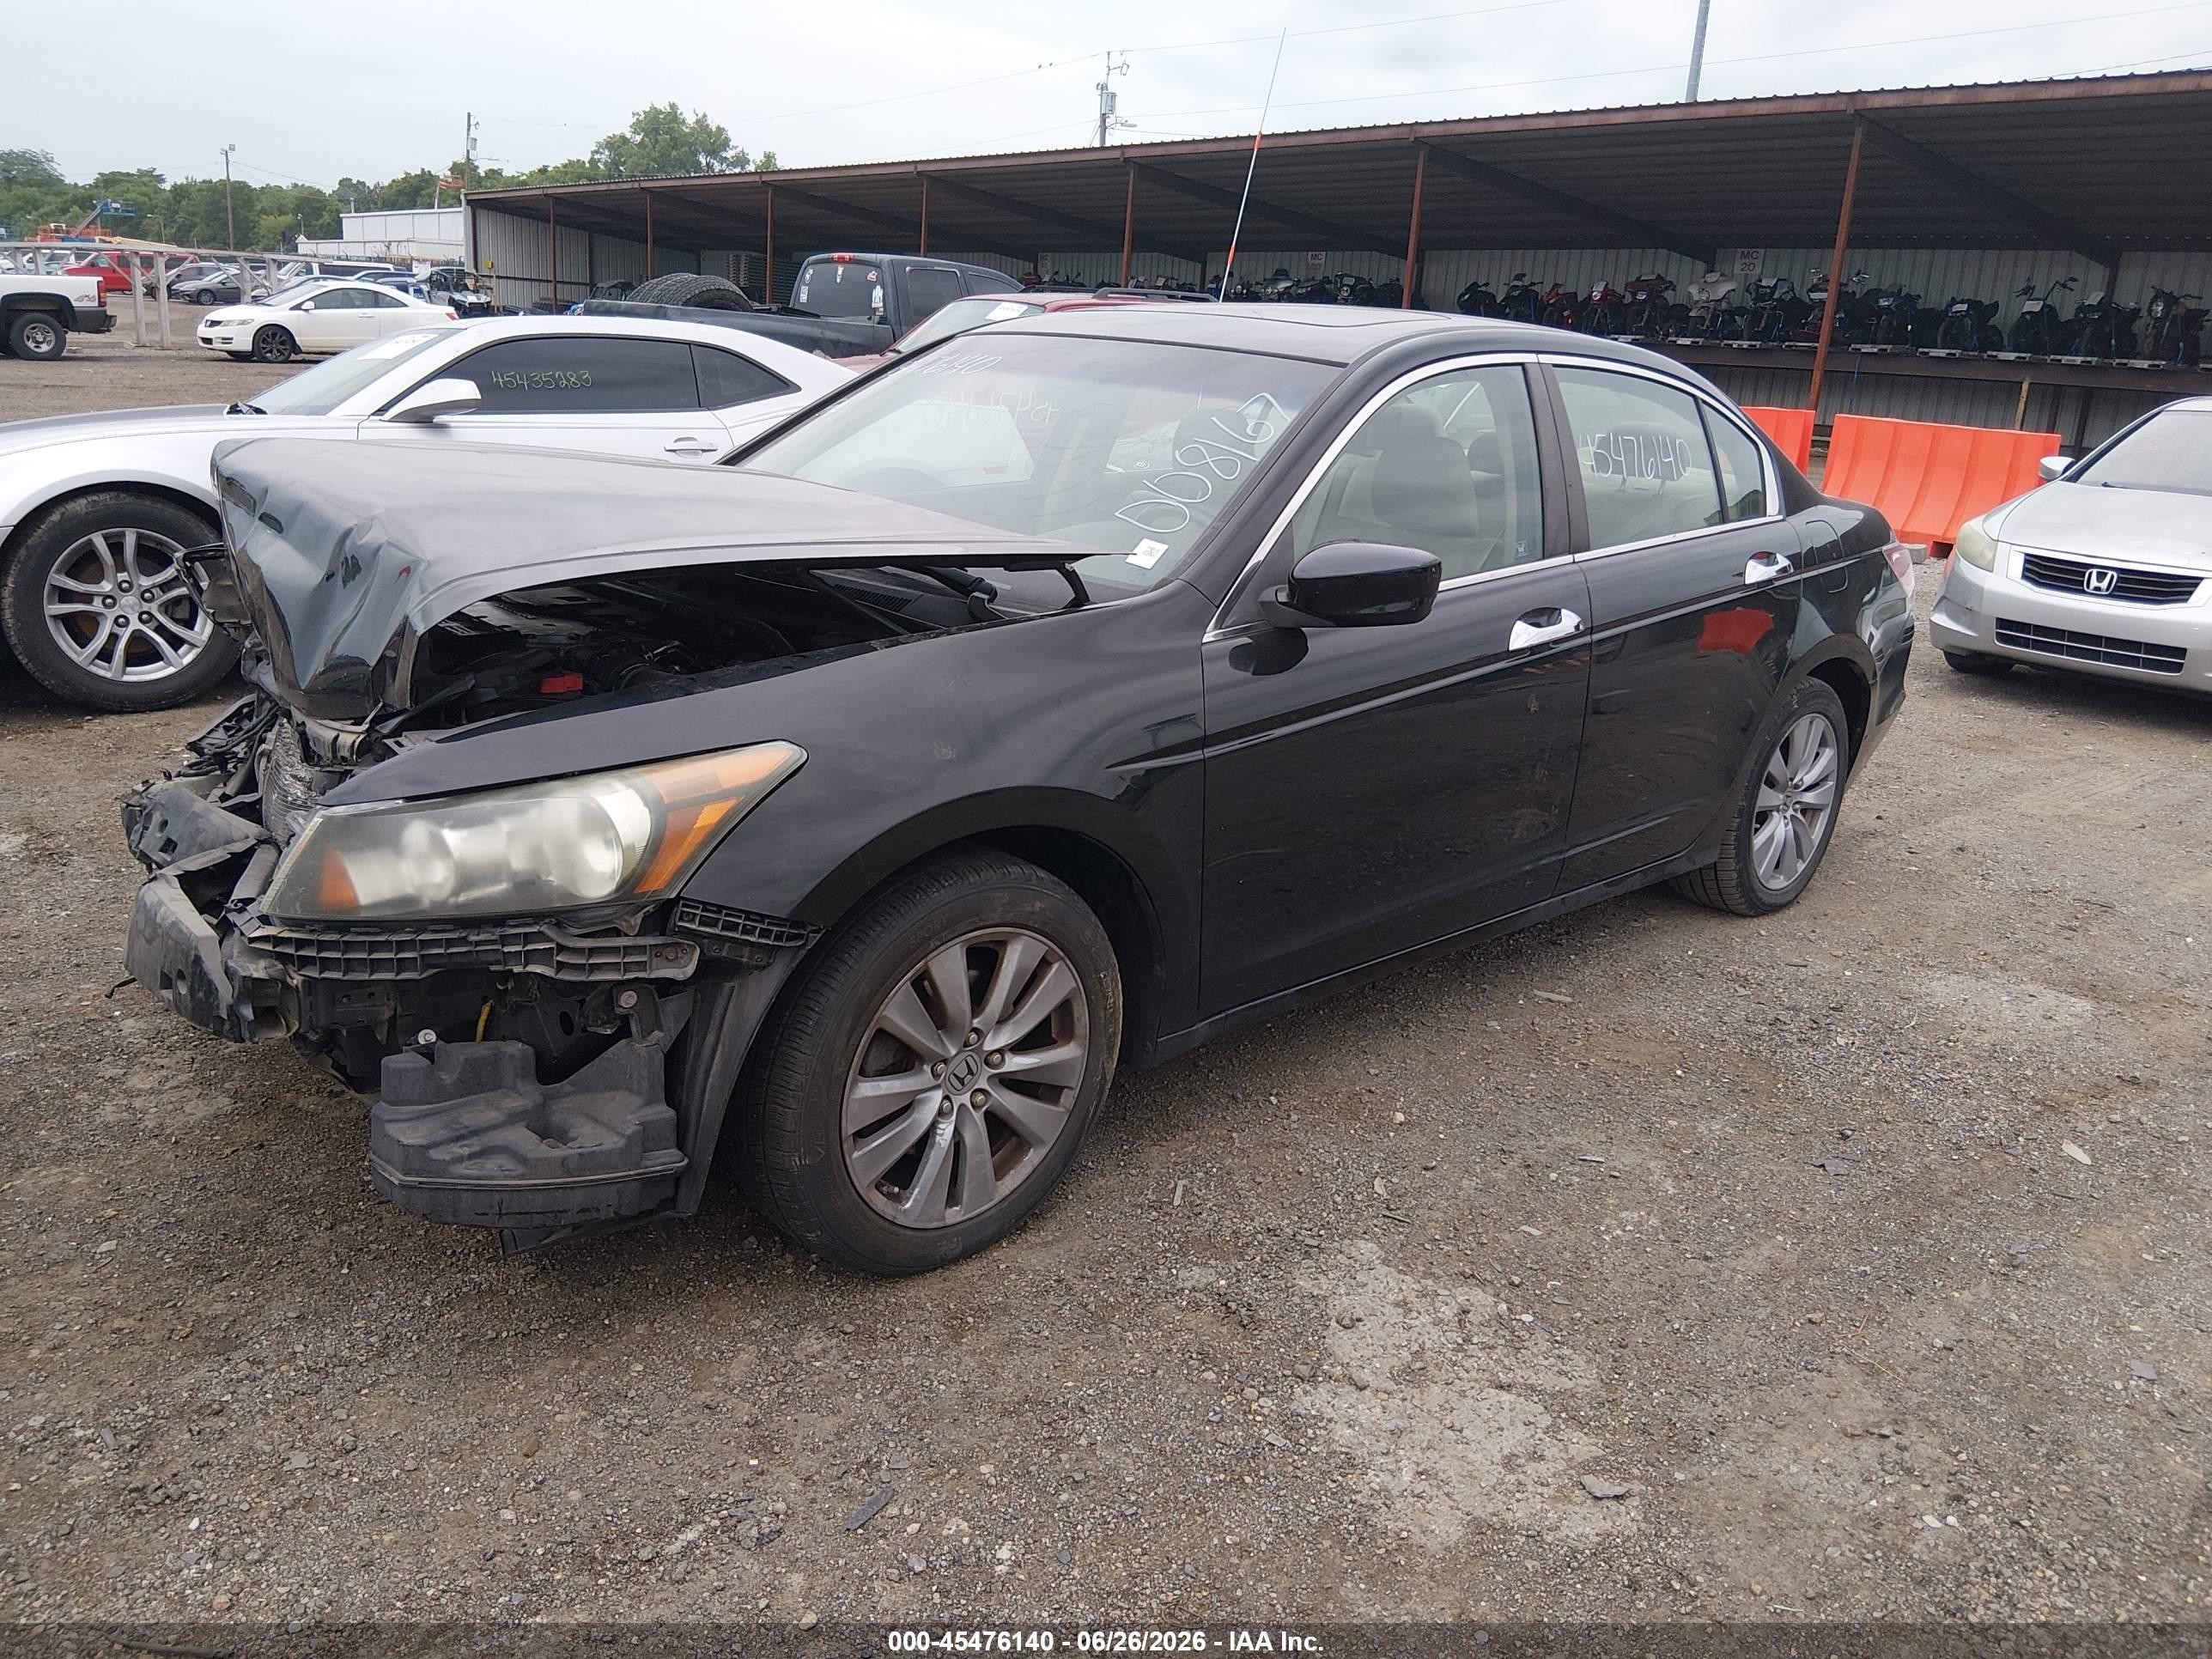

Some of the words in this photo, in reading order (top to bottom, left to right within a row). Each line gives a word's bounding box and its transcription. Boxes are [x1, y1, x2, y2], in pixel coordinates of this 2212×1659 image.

[1740, 250, 1759, 260] MC
[1740, 262, 1756, 272] 20
[491, 369, 593, 392] 45435283
[1577, 432, 1692, 481] 45476140
